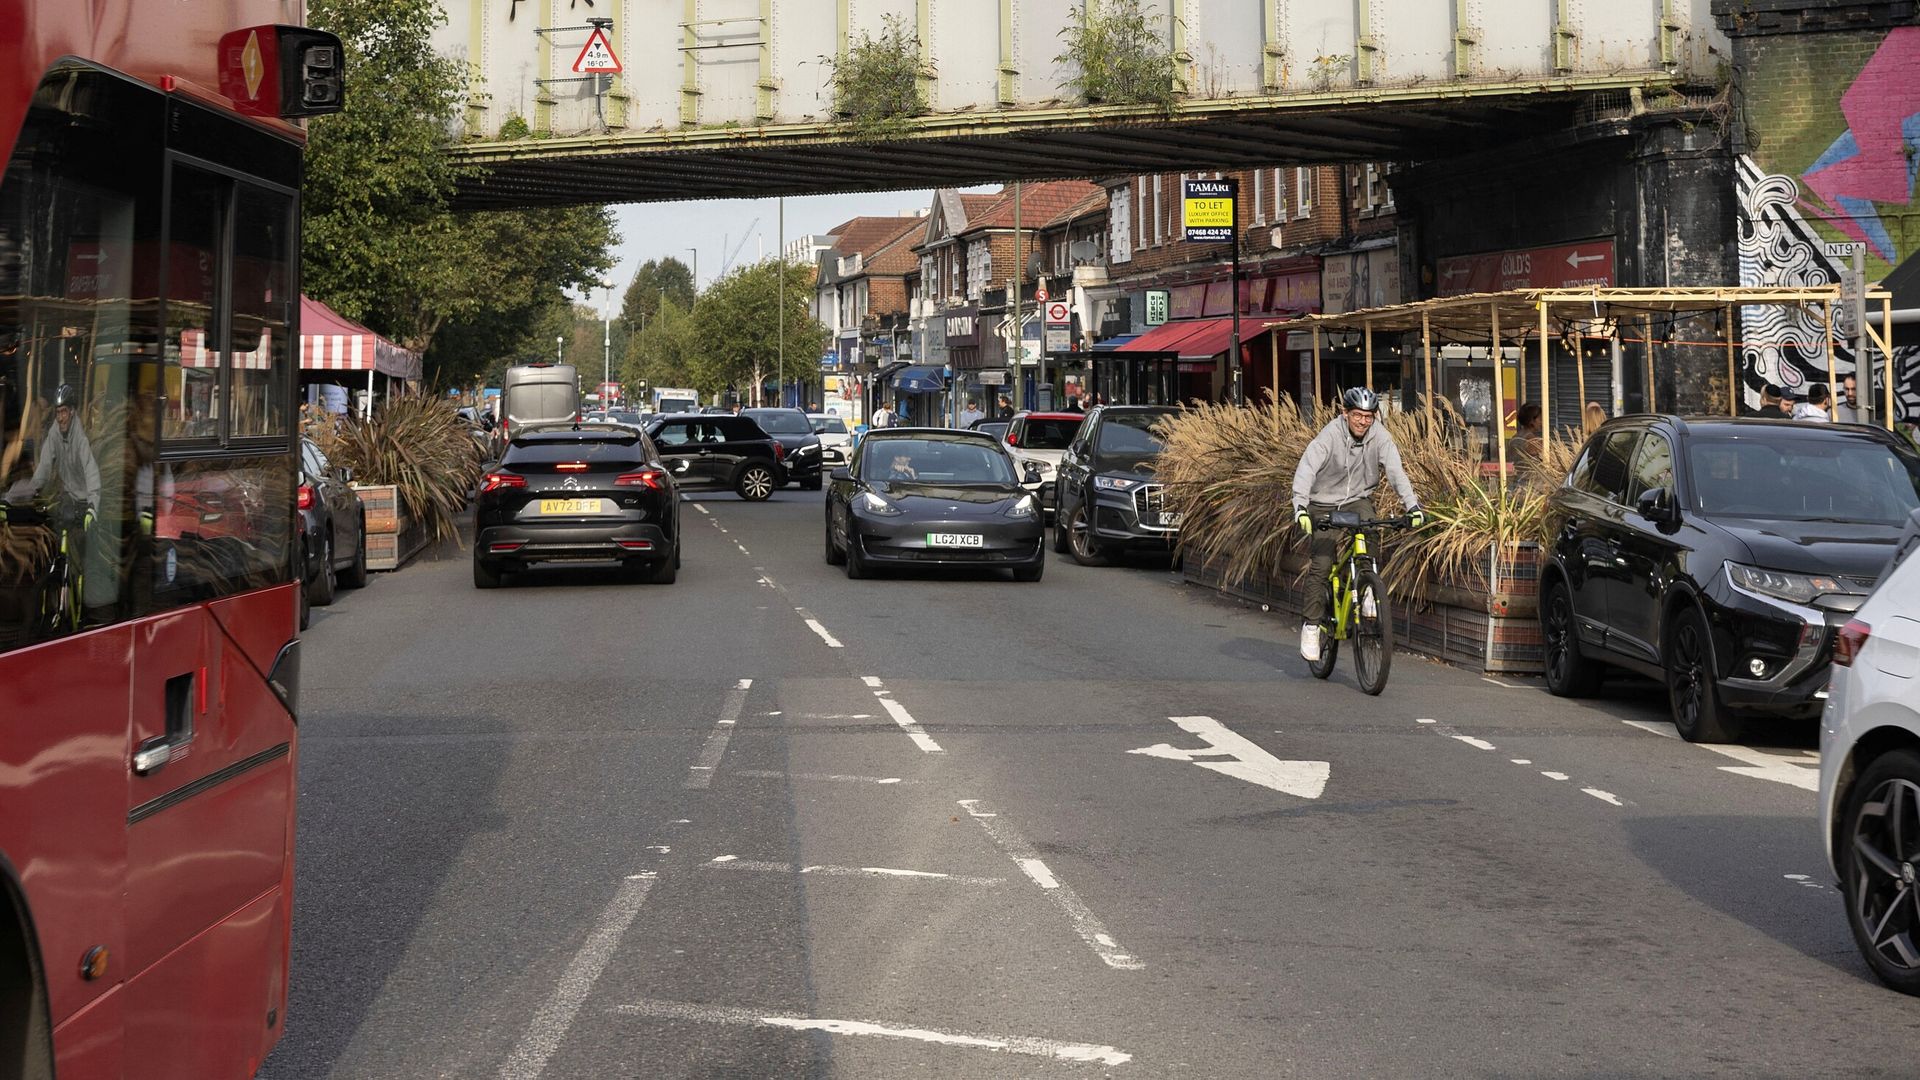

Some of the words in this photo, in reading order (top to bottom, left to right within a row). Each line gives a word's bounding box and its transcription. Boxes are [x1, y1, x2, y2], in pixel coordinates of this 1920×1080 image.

[1194, 201, 1206, 210] TO
[1209, 201, 1224, 210] LET
[1501, 253, 1531, 277] GOLD'S
[1038, 288, 1046, 301] S
[545, 501, 574, 512] AV72
[935, 535, 958, 545] LG21
[960, 536, 980, 546] XCB
